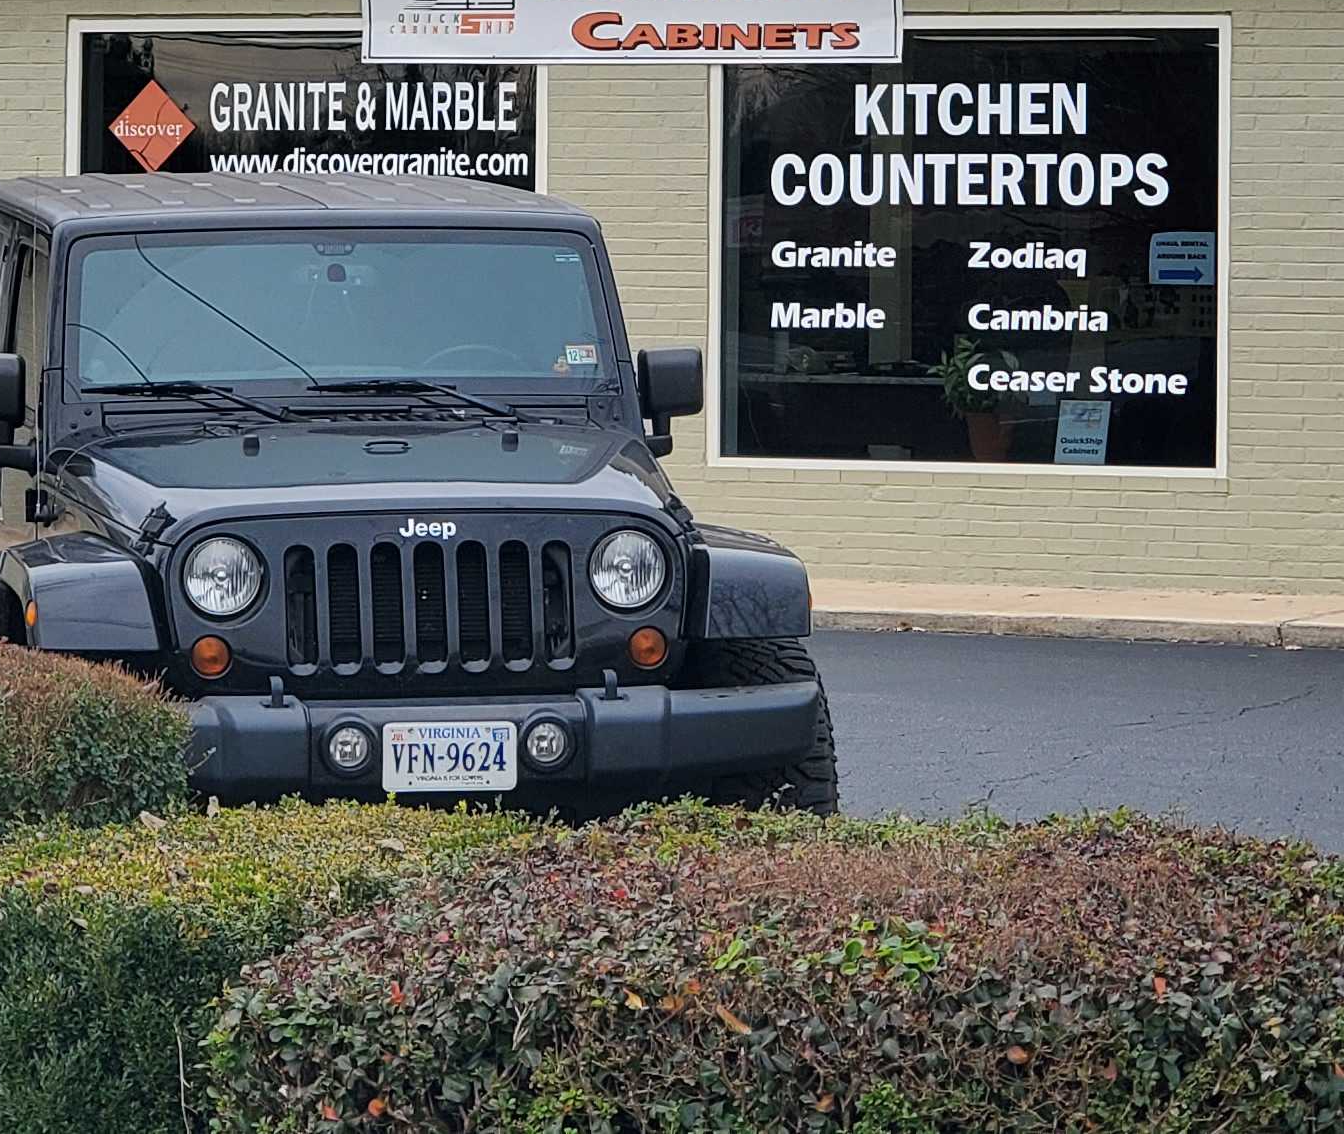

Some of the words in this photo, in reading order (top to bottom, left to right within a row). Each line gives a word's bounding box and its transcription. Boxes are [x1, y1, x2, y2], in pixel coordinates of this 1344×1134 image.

[390, 25, 460, 35] CABINET
[460, 13, 515, 35] SHIP
[398, 13, 460, 24] QUICK
[571, 11, 860, 51] CABINETS
[209, 81, 347, 133] GRANITE
[355, 82, 376, 132] &
[385, 81, 518, 133] MARBLE
[855, 82, 1087, 136] KITCHEN
[114, 117, 183, 139] discover
[770, 152, 1170, 207] COUNTERTOPS
[771, 241, 897, 268] Granite
[968, 242, 1087, 277] Zodiaq
[770, 302, 886, 330] Marble
[968, 304, 1109, 332] Cambria
[968, 364, 1081, 393] Ceaser
[1089, 366, 1188, 396] Stone
[399, 518, 456, 540] Jeep
[418, 727, 481, 739] VIRGINIA
[392, 742, 506, 773] VFN-9624
